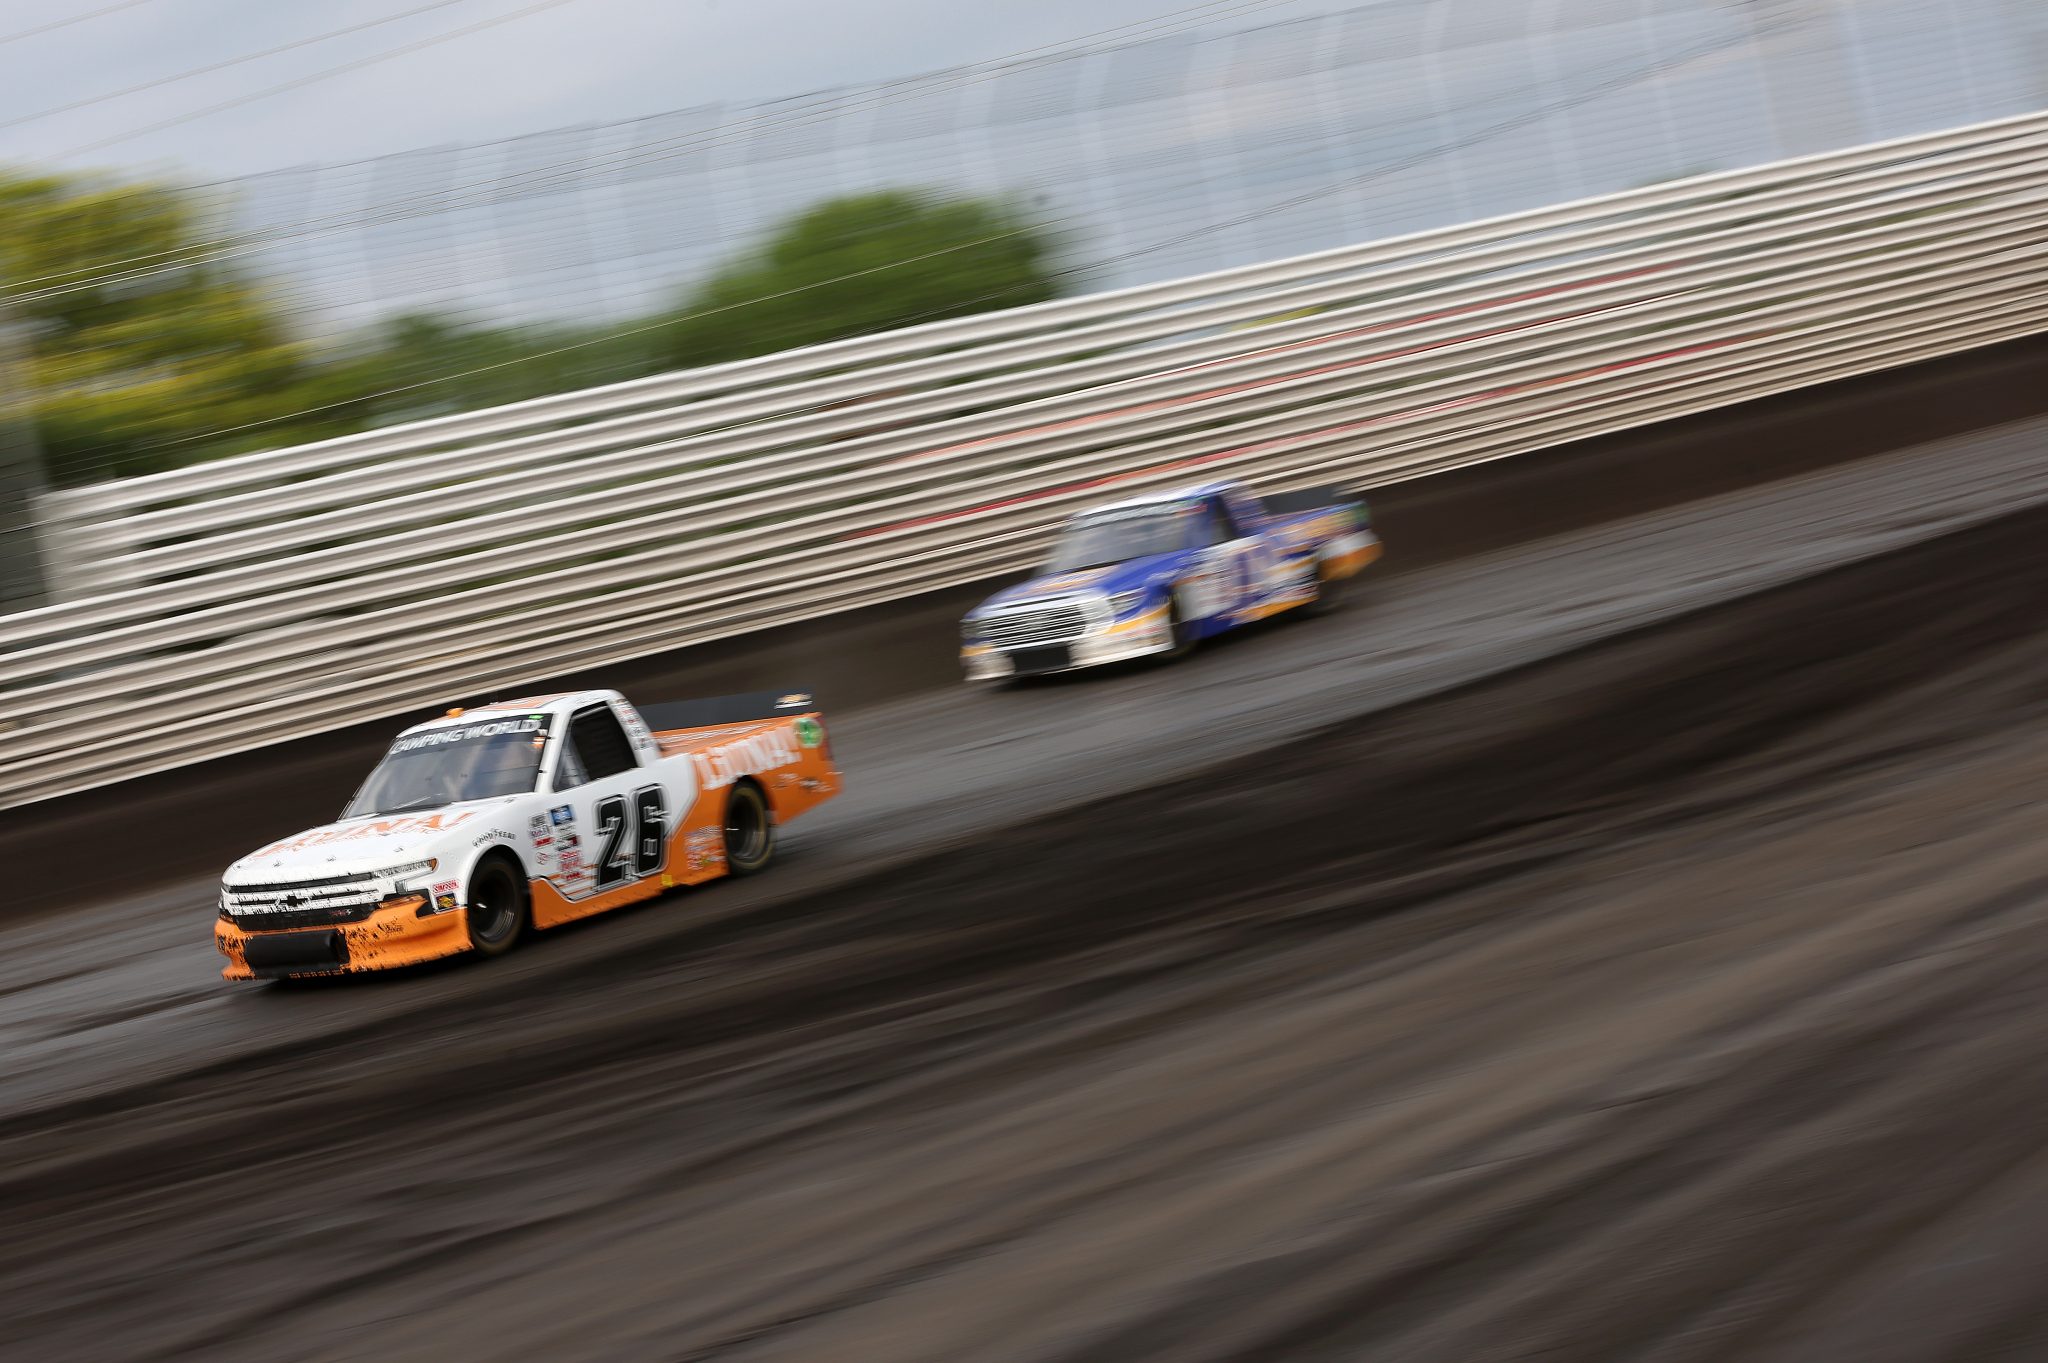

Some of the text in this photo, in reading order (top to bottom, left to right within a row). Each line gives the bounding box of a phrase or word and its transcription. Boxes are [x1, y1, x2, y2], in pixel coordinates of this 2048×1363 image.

[391, 719, 542, 755] CAMPING WORLD
[592, 783, 670, 892] 26
